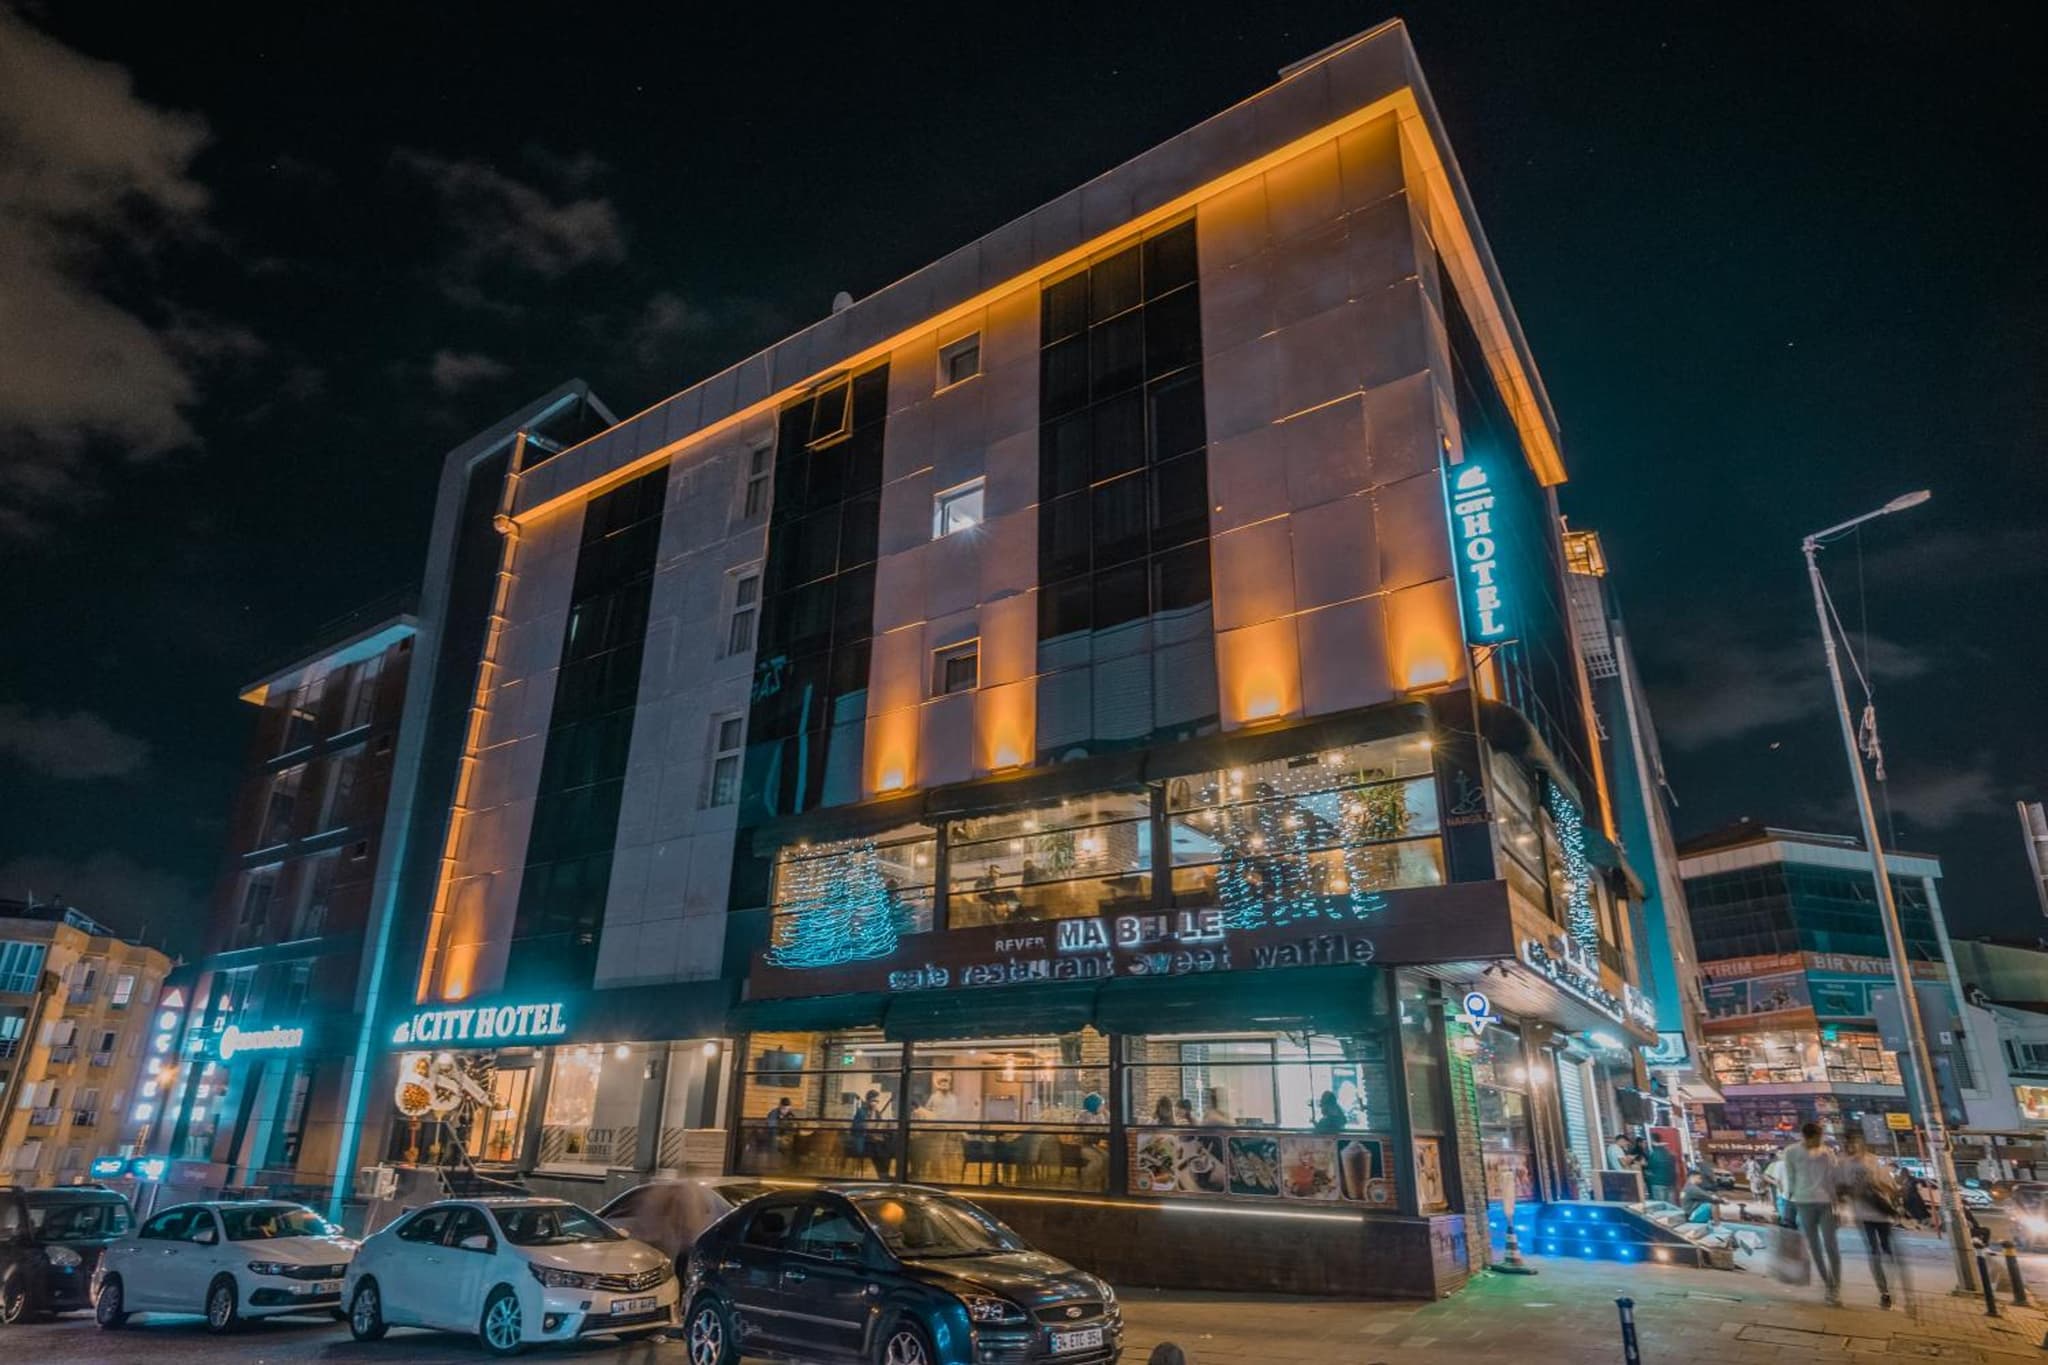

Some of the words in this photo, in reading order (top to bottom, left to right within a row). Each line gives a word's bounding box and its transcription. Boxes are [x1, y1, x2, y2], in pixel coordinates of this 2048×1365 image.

[1462, 511, 1504, 636] HOTEL
[1057, 917, 1109, 950] MA
[1115, 909, 1225, 947] BELLE
[960, 952, 1116, 985] restaurant
[1127, 943, 1232, 975] sweet
[1253, 933, 1376, 968] waffle
[416, 1010, 475, 1042] CITY
[474, 1003, 566, 1039] HOTEL
